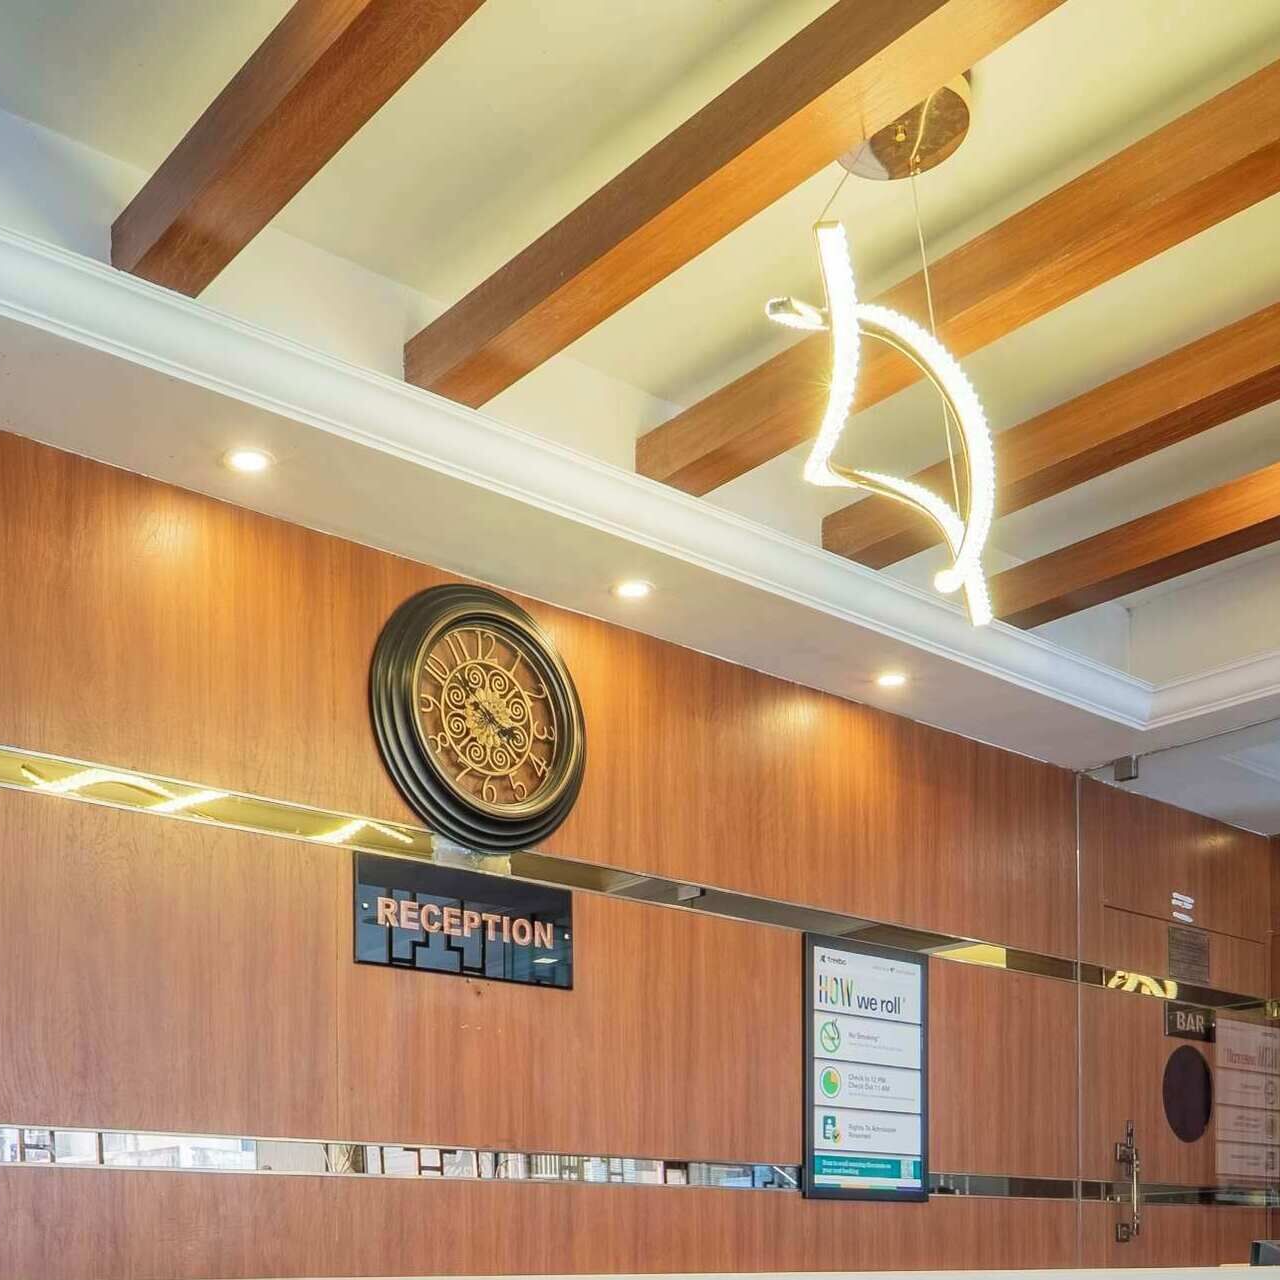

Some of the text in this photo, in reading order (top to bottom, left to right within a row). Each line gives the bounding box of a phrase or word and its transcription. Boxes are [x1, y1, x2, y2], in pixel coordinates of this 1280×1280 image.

[475, 631, 497, 664] 12
[420, 694, 442, 712] 9
[429, 731, 449, 754] 8
[533, 721, 555, 741] 3
[529, 752, 552, 777] 4
[483, 775, 497, 803] 6
[509, 771, 527, 801] 5
[376, 896, 555, 950] RECEPTION
[819, 974, 901, 1014] HOW we roll
[1176, 1011, 1205, 1033] BAR
